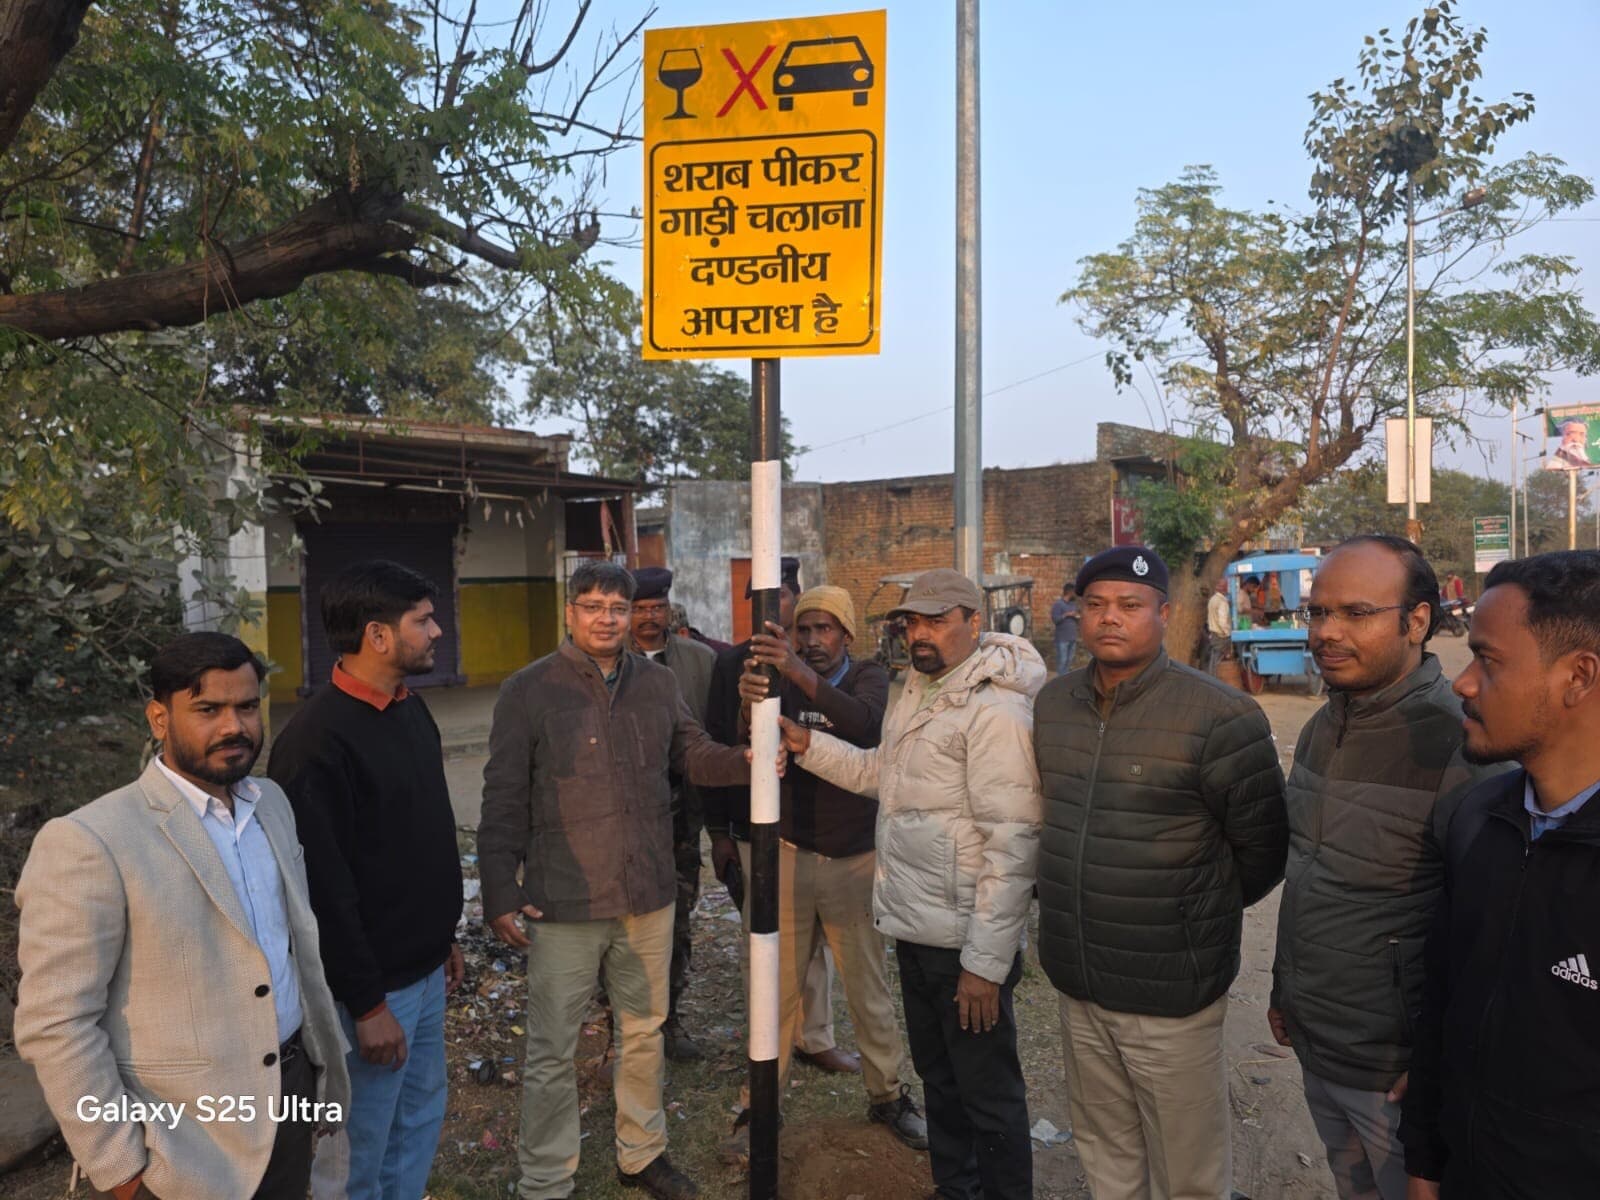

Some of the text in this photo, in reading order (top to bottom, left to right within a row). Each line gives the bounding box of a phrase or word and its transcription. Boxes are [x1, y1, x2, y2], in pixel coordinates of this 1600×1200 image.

[663, 146, 864, 192] शराब पीकर
[659, 196, 865, 248] गाड़ी चलाना
[690, 244, 831, 286] दण्डनीय
[681, 293, 842, 336] अपराध है
[1551, 965, 1598, 990] adidas
